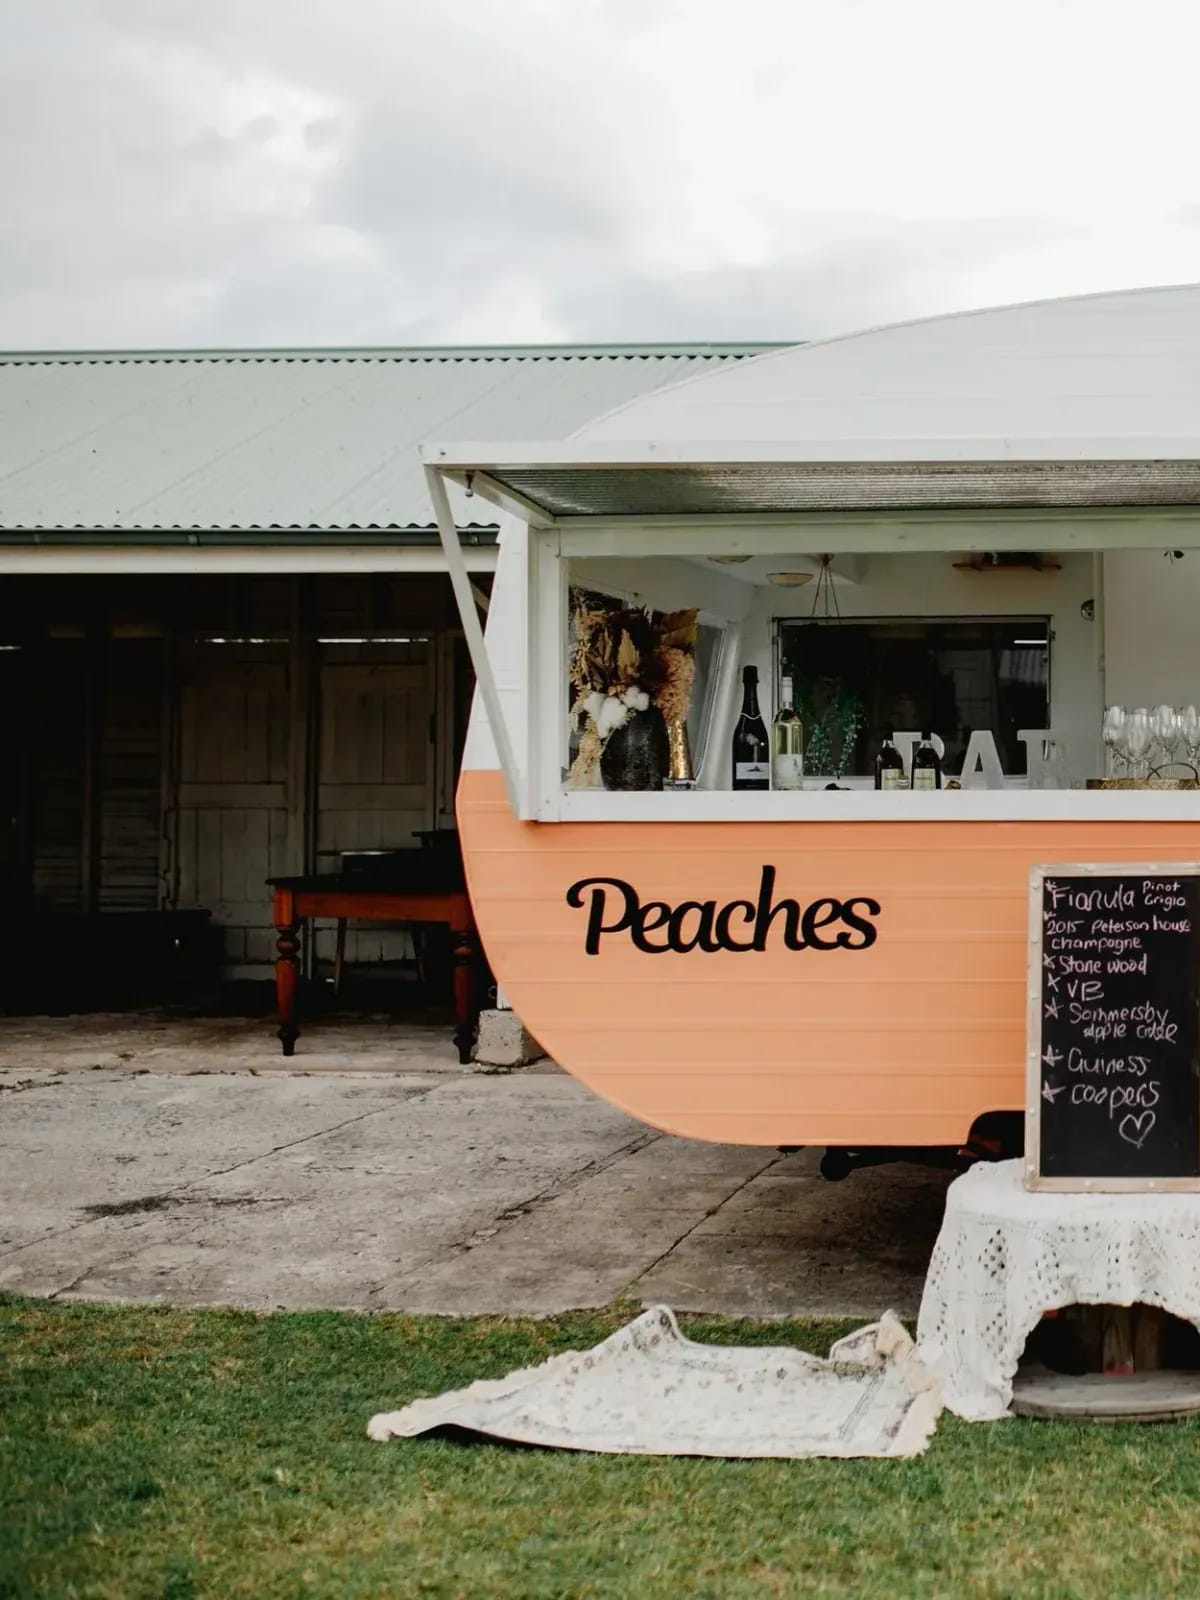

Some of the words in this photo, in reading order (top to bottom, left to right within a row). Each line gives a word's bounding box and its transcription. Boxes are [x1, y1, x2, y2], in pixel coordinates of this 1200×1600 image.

[566, 865, 881, 955] Peaches
[1046, 920, 1085, 935] 2015
[1153, 915, 1191, 932] house
[1051, 937, 1142, 955] champagne
[1060, 955, 1102, 975] Stone
[1107, 953, 1147, 975] wood
[1067, 979, 1104, 1001] VB
[1067, 1047, 1151, 1077] Guiness
